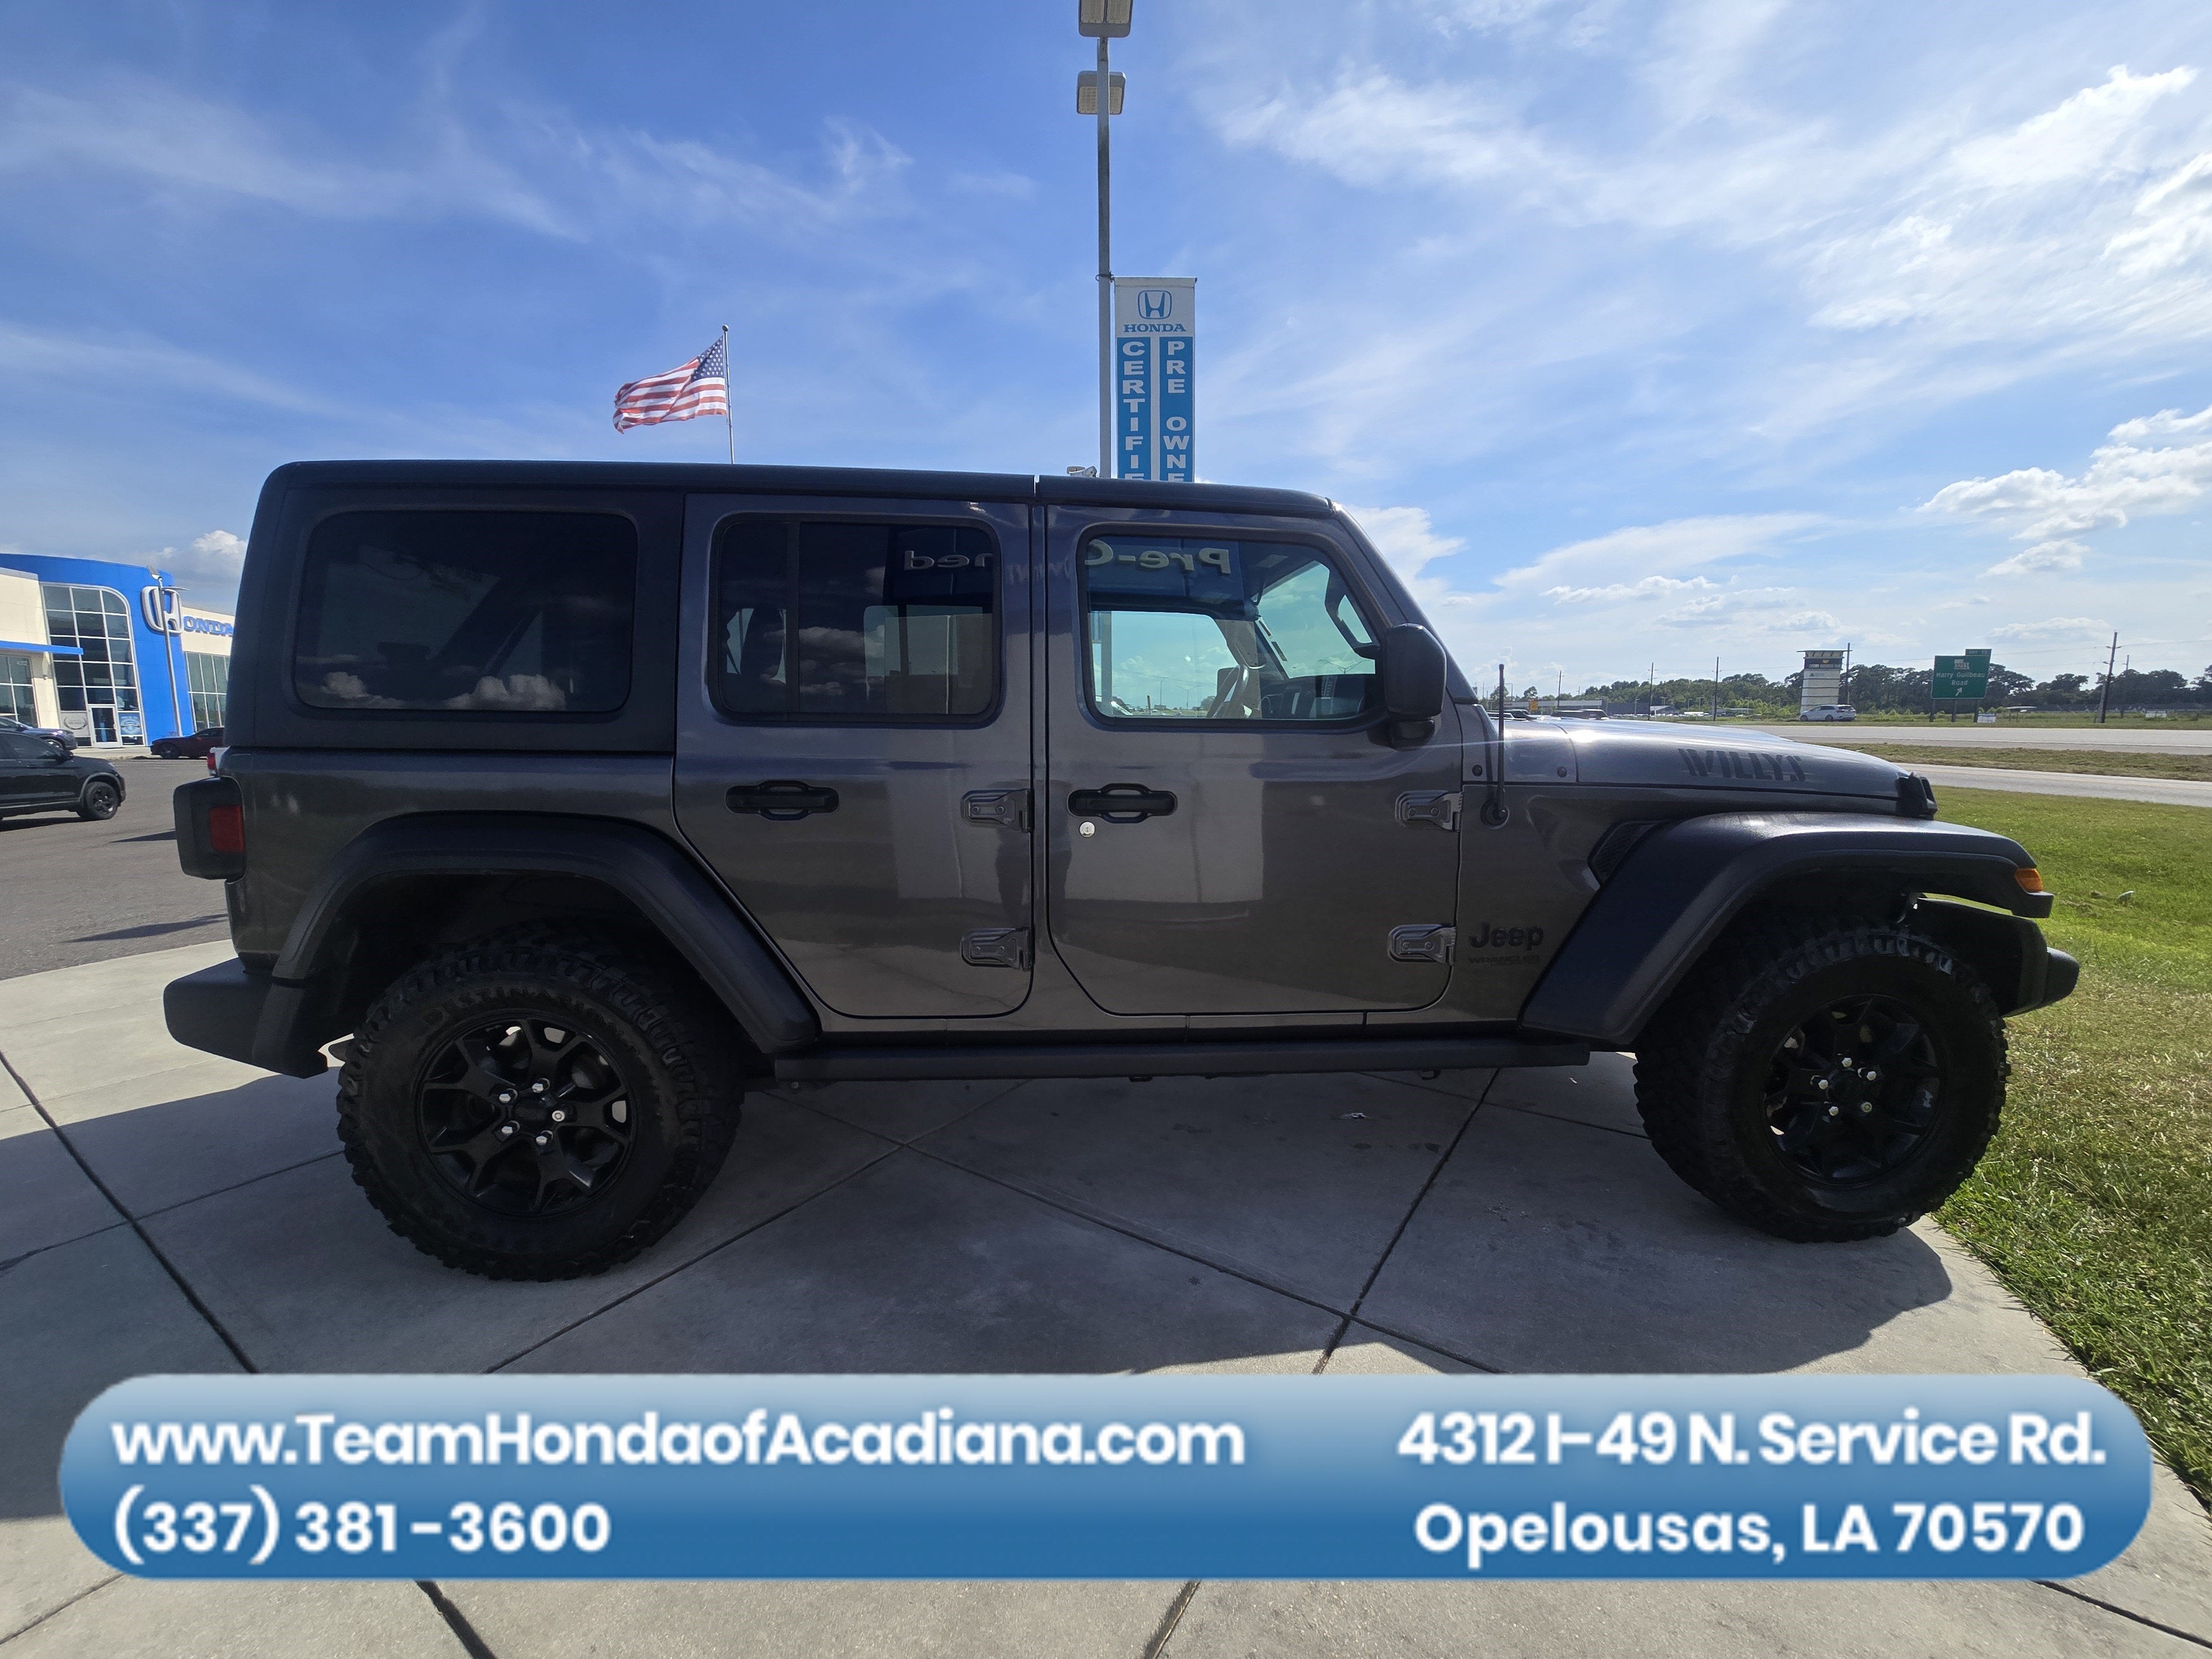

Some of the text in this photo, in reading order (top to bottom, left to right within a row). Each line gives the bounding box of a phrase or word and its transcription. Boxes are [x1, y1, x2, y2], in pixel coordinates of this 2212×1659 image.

[1124, 324, 1186, 332] HONDA
[1122, 341, 1145, 480] CERTIFI
[1163, 341, 1190, 482] PRE OWNE
[184, 615, 233, 637] ONDA
[1677, 748, 1806, 782] WILLYS
[1469, 921, 1544, 951] Jeep
